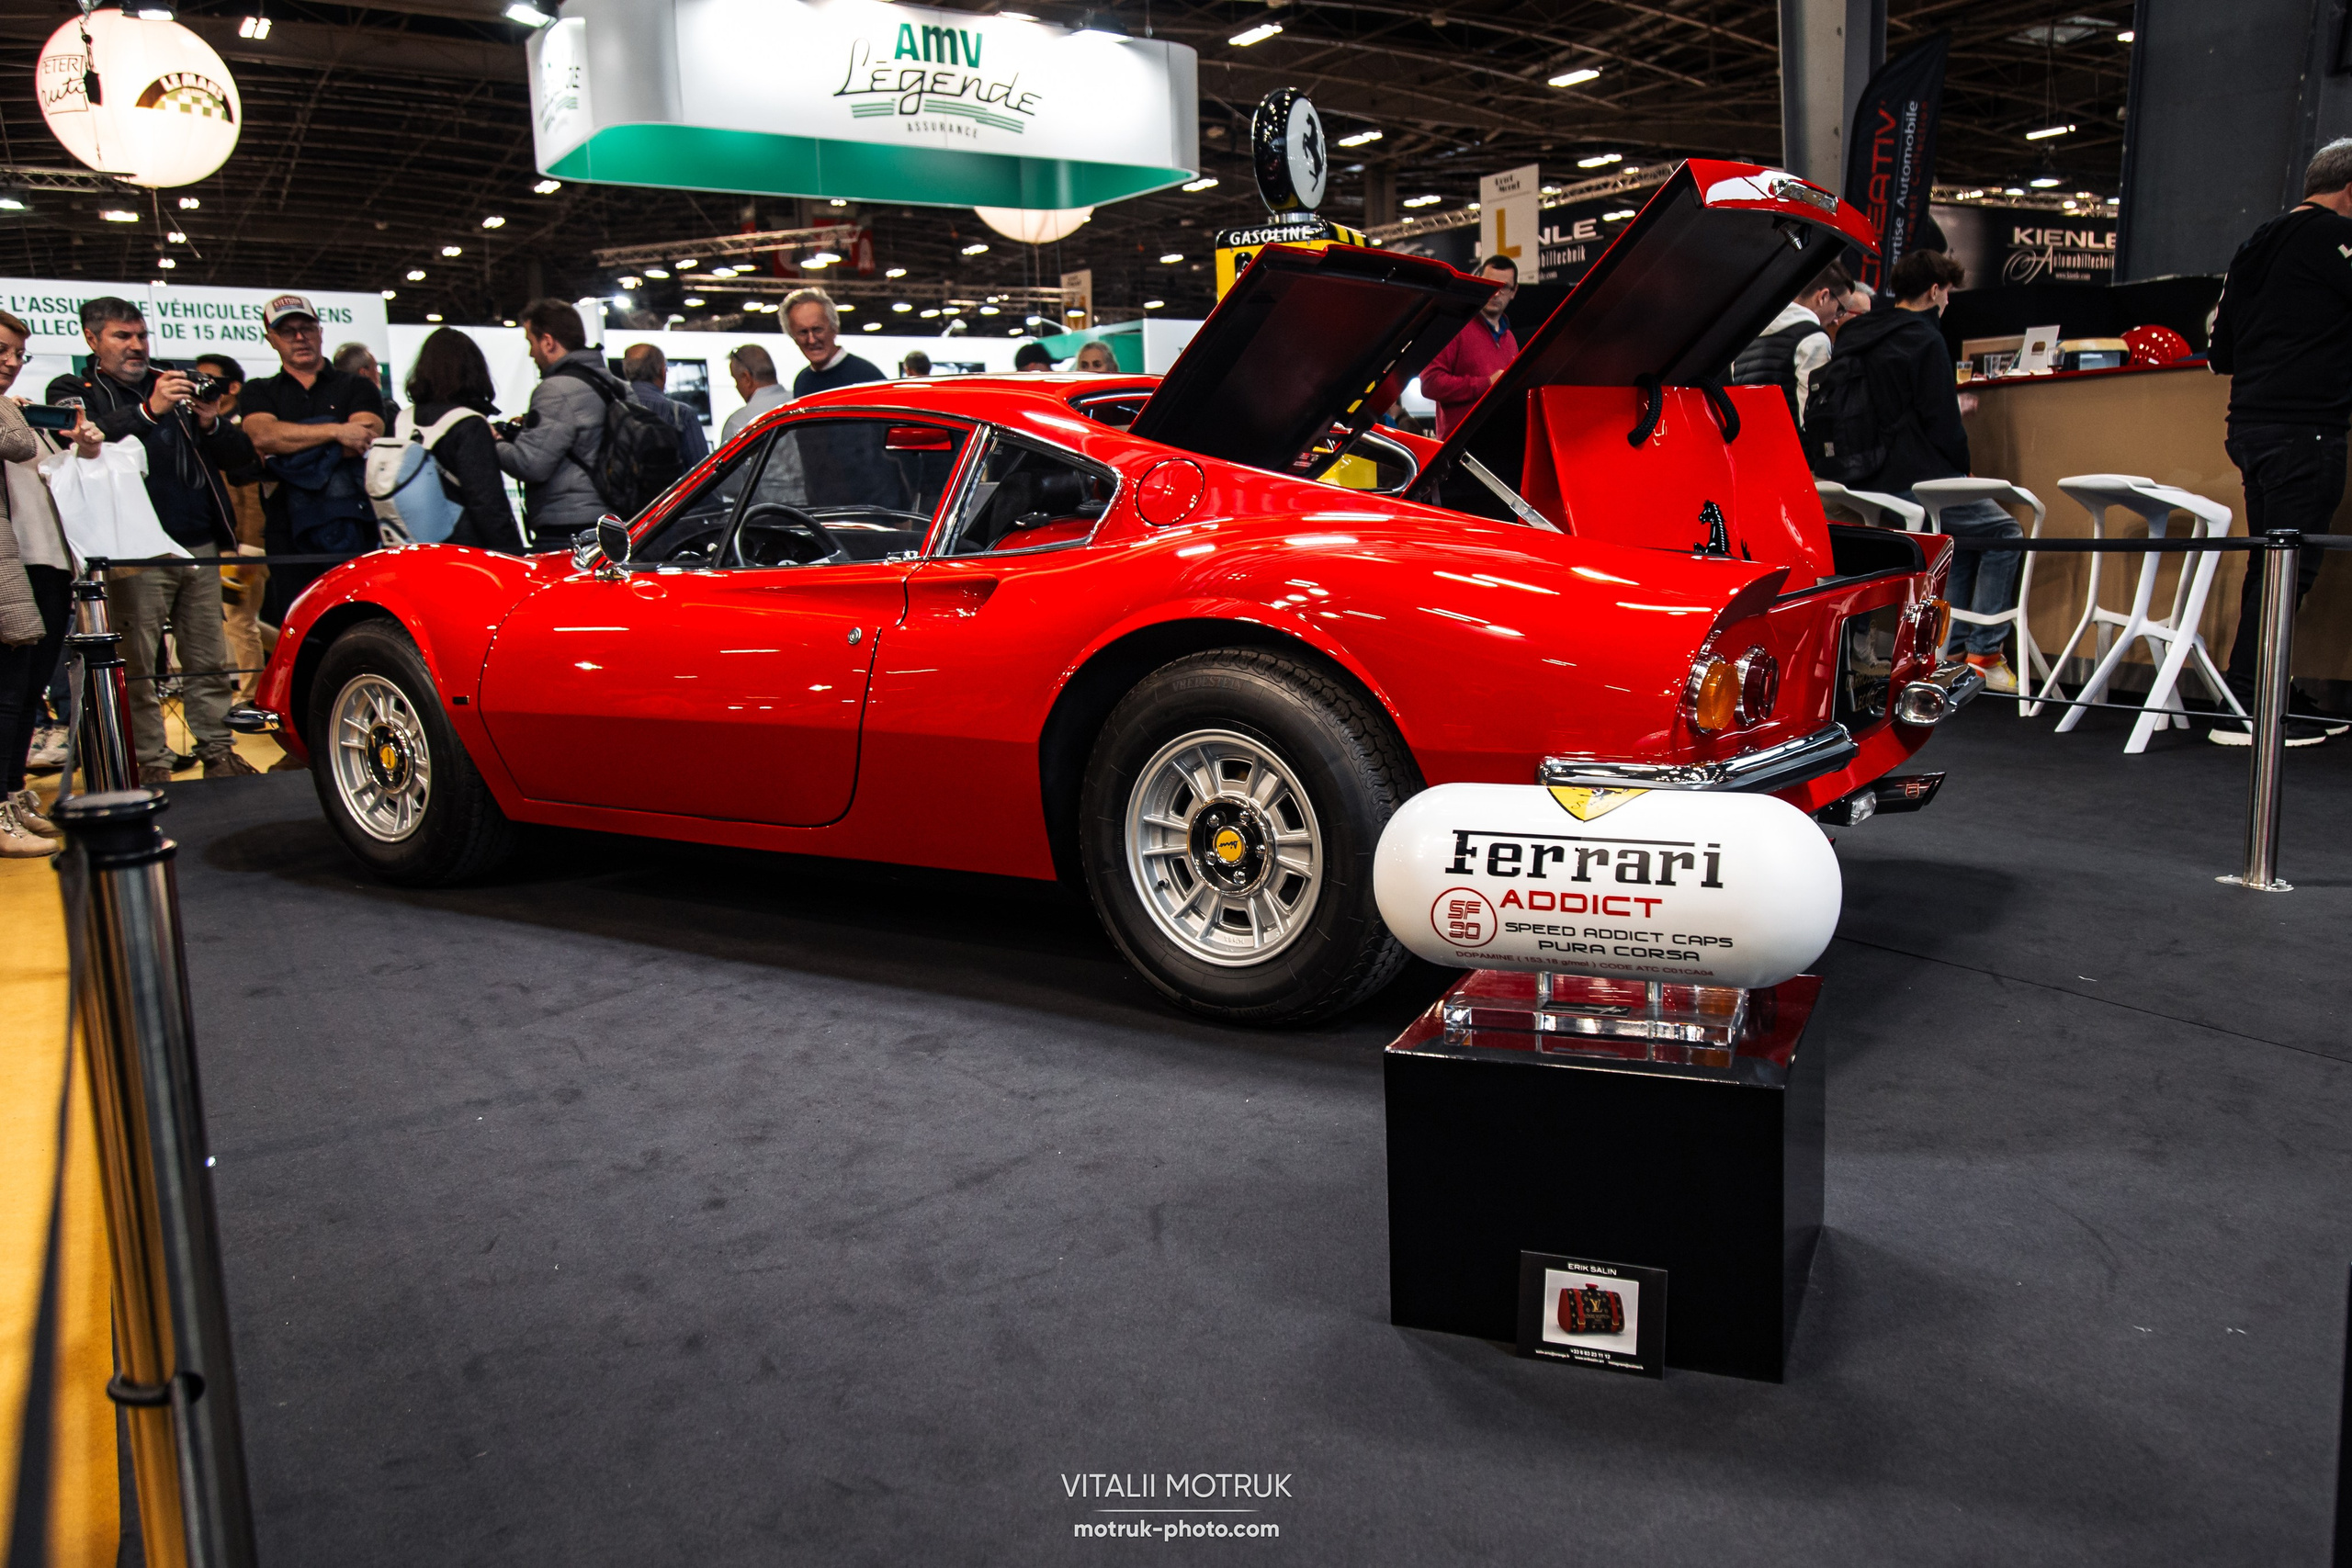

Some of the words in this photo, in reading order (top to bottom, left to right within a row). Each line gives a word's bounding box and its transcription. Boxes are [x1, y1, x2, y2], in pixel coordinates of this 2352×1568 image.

[907, 120, 979, 140] ASSURANCE
[1885, 217, 1905, 298] Eertise
[1896, 100, 1919, 209] Automobile
[1228, 225, 1312, 246] GASOLINE
[1496, 208, 1521, 258] L
[2013, 226, 2117, 250] KIENLE
[2004, 243, 2115, 285] Automobiltechni
[157, 298, 264, 321] VÉHICULES
[162, 322, 187, 340] DE
[194, 324, 215, 341] 15
[220, 325, 265, 345] ANS)
[1444, 829, 1724, 889] Ferrari
[1447, 899, 1482, 920] SF
[1498, 888, 1663, 919] ADDICT
[1504, 921, 1577, 937] SPEED
[1582, 927, 1665, 943] ADDICT
[1671, 933, 1734, 949] CAPS
[1454, 950, 1515, 962] DOPAMINE
[1524, 956, 1558, 964] 153.18
[1561, 959, 1589, 967] g/mol
[1599, 962, 1634, 971] CODE
[1635, 964, 1660, 973] ATC
[1537, 939, 1607, 955] PURA
[1612, 945, 1701, 963] CORSA
[1567, 1262, 1589, 1273] ERIK
[1590, 1265, 1617, 1276] SALIN
